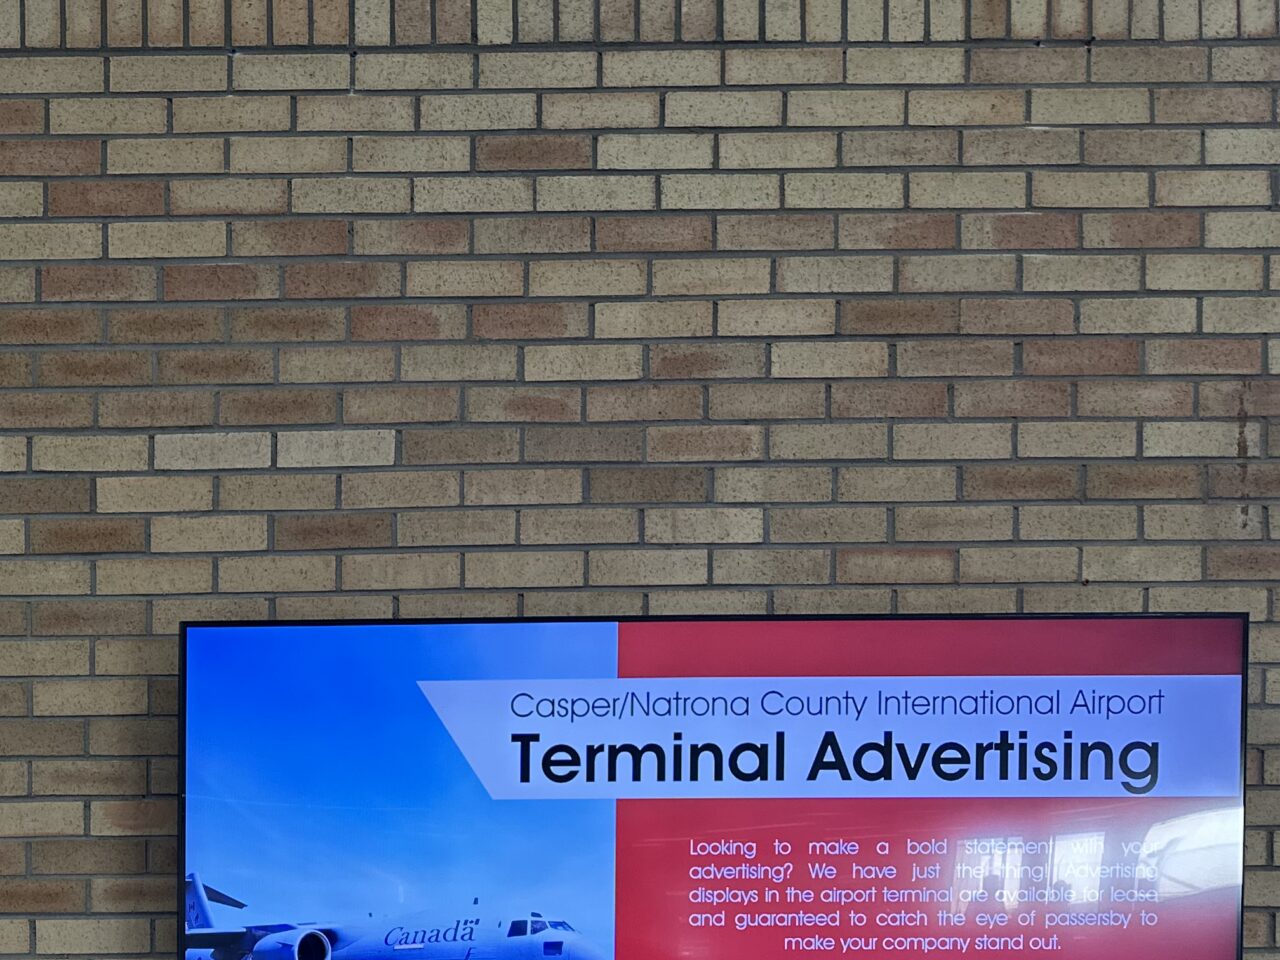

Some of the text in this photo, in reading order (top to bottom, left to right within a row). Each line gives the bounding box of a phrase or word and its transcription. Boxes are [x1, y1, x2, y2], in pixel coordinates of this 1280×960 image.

[511, 689, 1165, 723] Casper/Natrona County International Airport
[511, 731, 1159, 794] Terminal Advertising
[690, 839, 756, 858] Looking
[774, 839, 792, 854] to
[808, 839, 859, 854] make
[877, 842, 888, 854] a
[908, 839, 947, 854] bold
[965, 839, 1053, 854] statement
[689, 863, 793, 882] advertising?
[808, 863, 836, 878] We
[853, 863, 896, 878] have
[912, 863, 941, 881] just
[956, 863, 984, 878] the
[689, 887, 758, 905] displays
[765, 888, 781, 902] in
[786, 887, 814, 902] the
[820, 887, 877, 905] airport
[883, 886, 953, 902] terminal
[960, 889, 988, 902] are
[1111, 886, 1158, 902] lease
[689, 910, 1158, 930] and guaranteed to catch the eye of passersby to
[384, 920, 476, 946] Canada
[785, 934, 1061, 954] make your company stand out.
